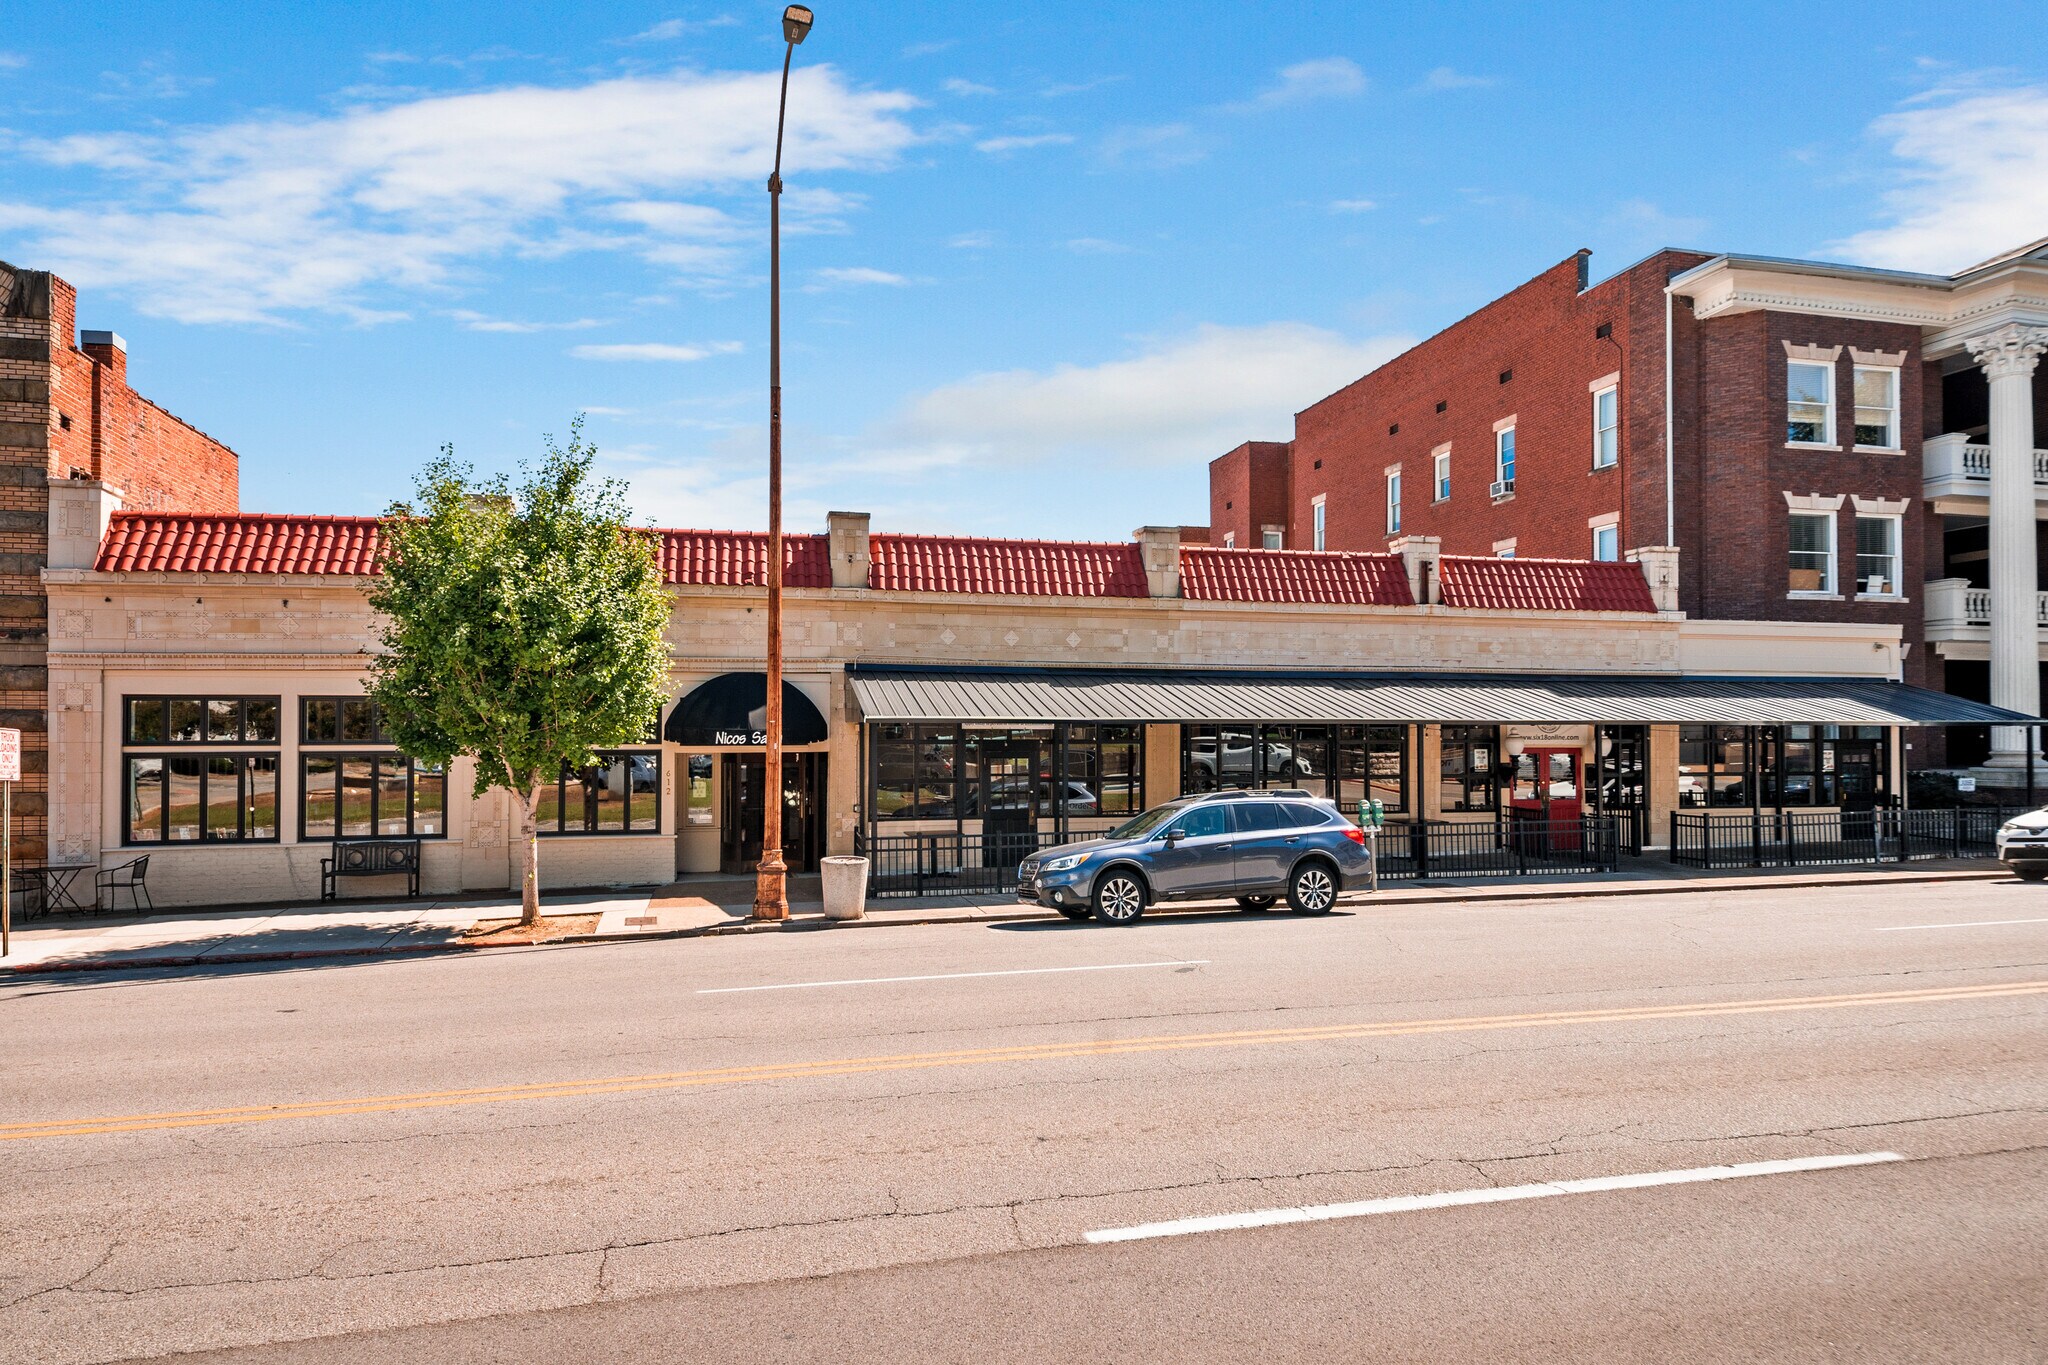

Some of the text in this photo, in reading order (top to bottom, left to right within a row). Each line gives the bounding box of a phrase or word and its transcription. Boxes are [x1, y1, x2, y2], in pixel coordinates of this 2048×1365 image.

[1, 732, 15, 742] TRUCK
[715, 731, 746, 745] Nicos
[2, 753, 14, 763] ONLY
